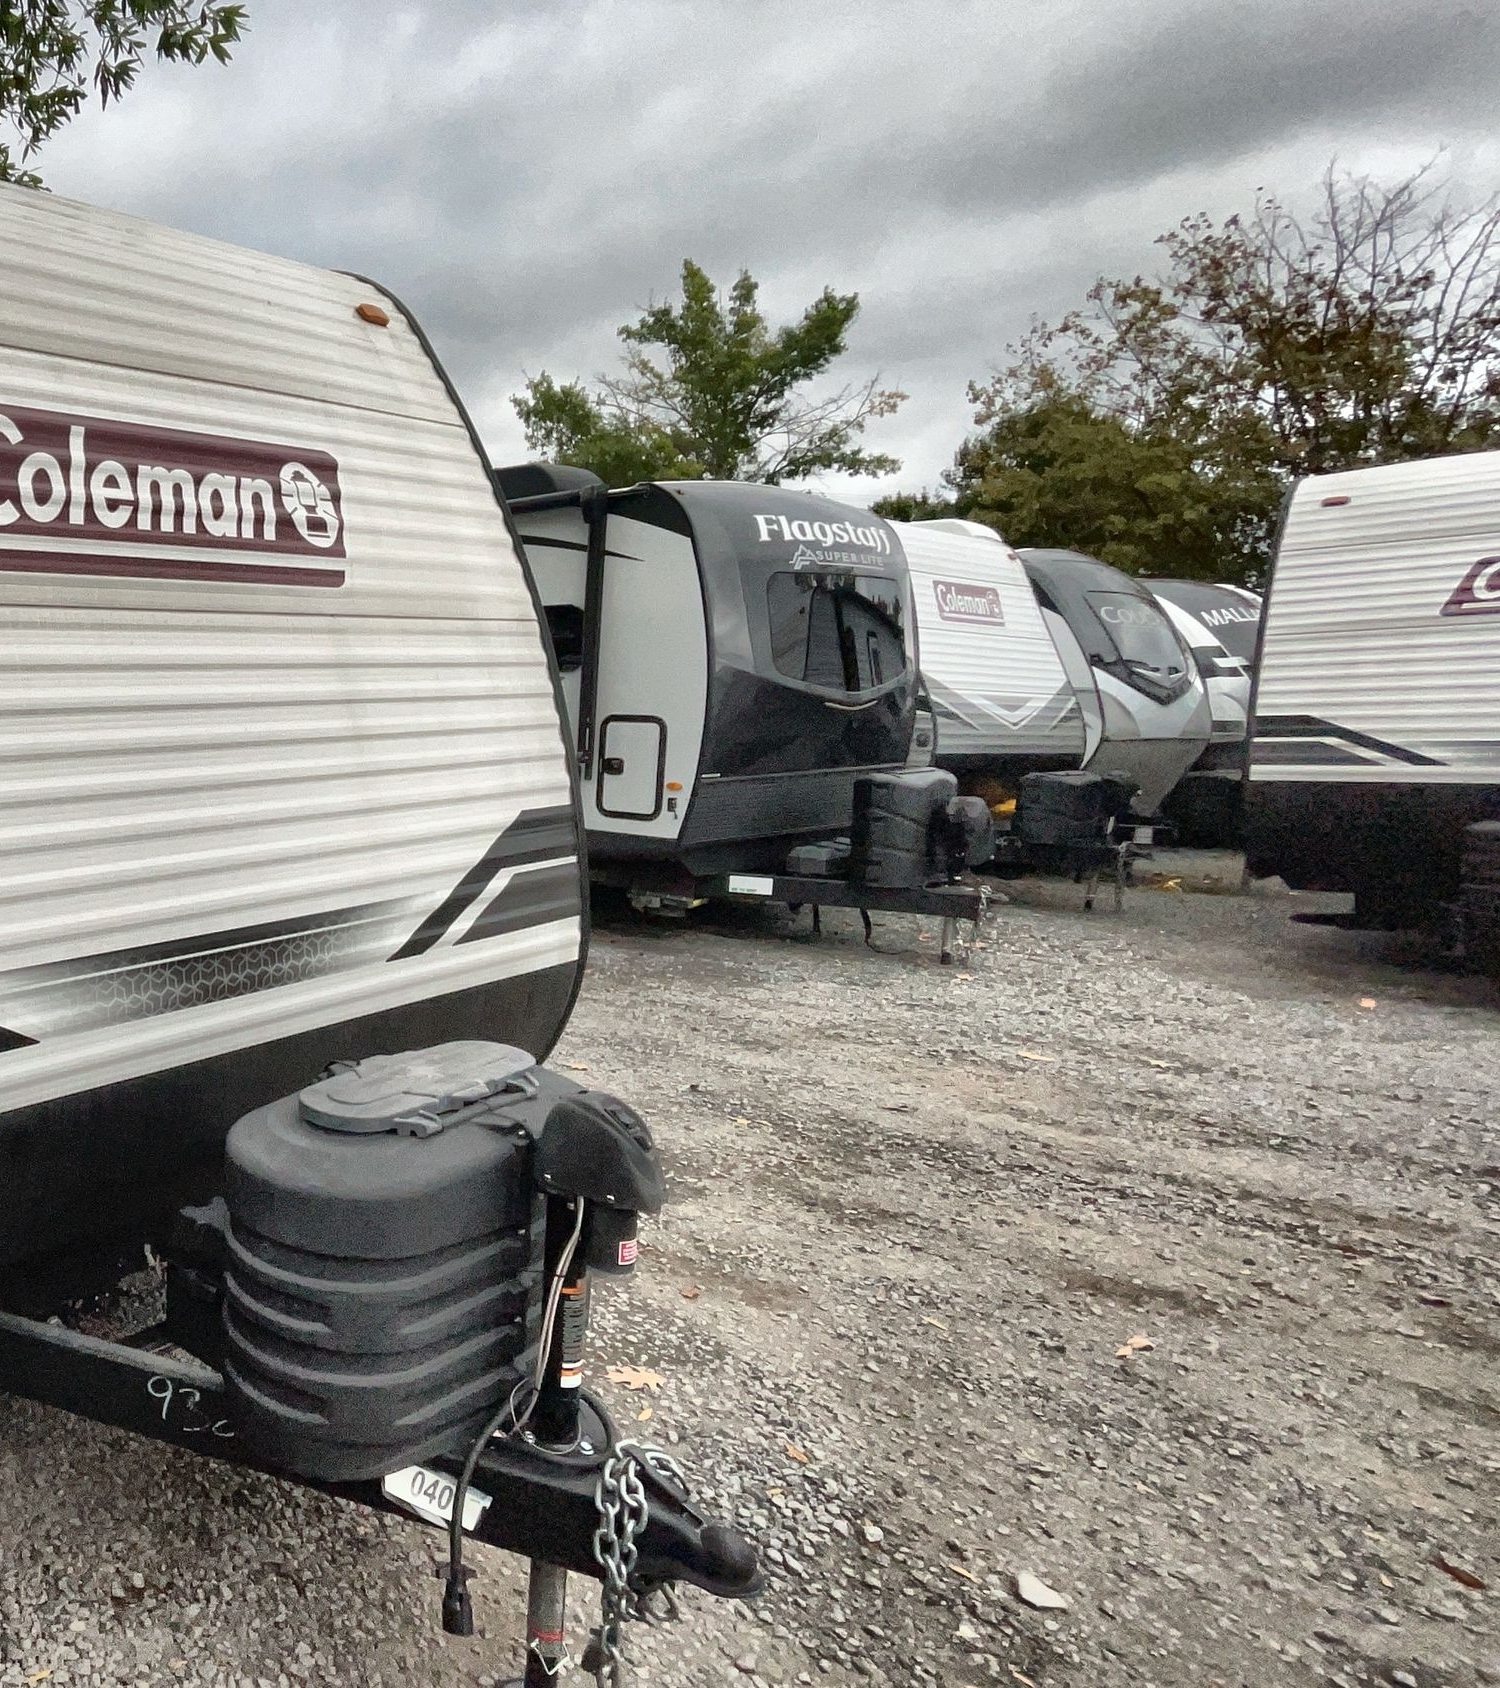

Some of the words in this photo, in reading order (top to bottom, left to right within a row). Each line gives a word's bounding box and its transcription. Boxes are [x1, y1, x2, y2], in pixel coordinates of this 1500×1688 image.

[753, 514, 890, 555] Flagstaff
[815, 550, 858, 563] SUPER
[860, 554, 884, 566] LITE
[937, 584, 991, 616] Coleman
